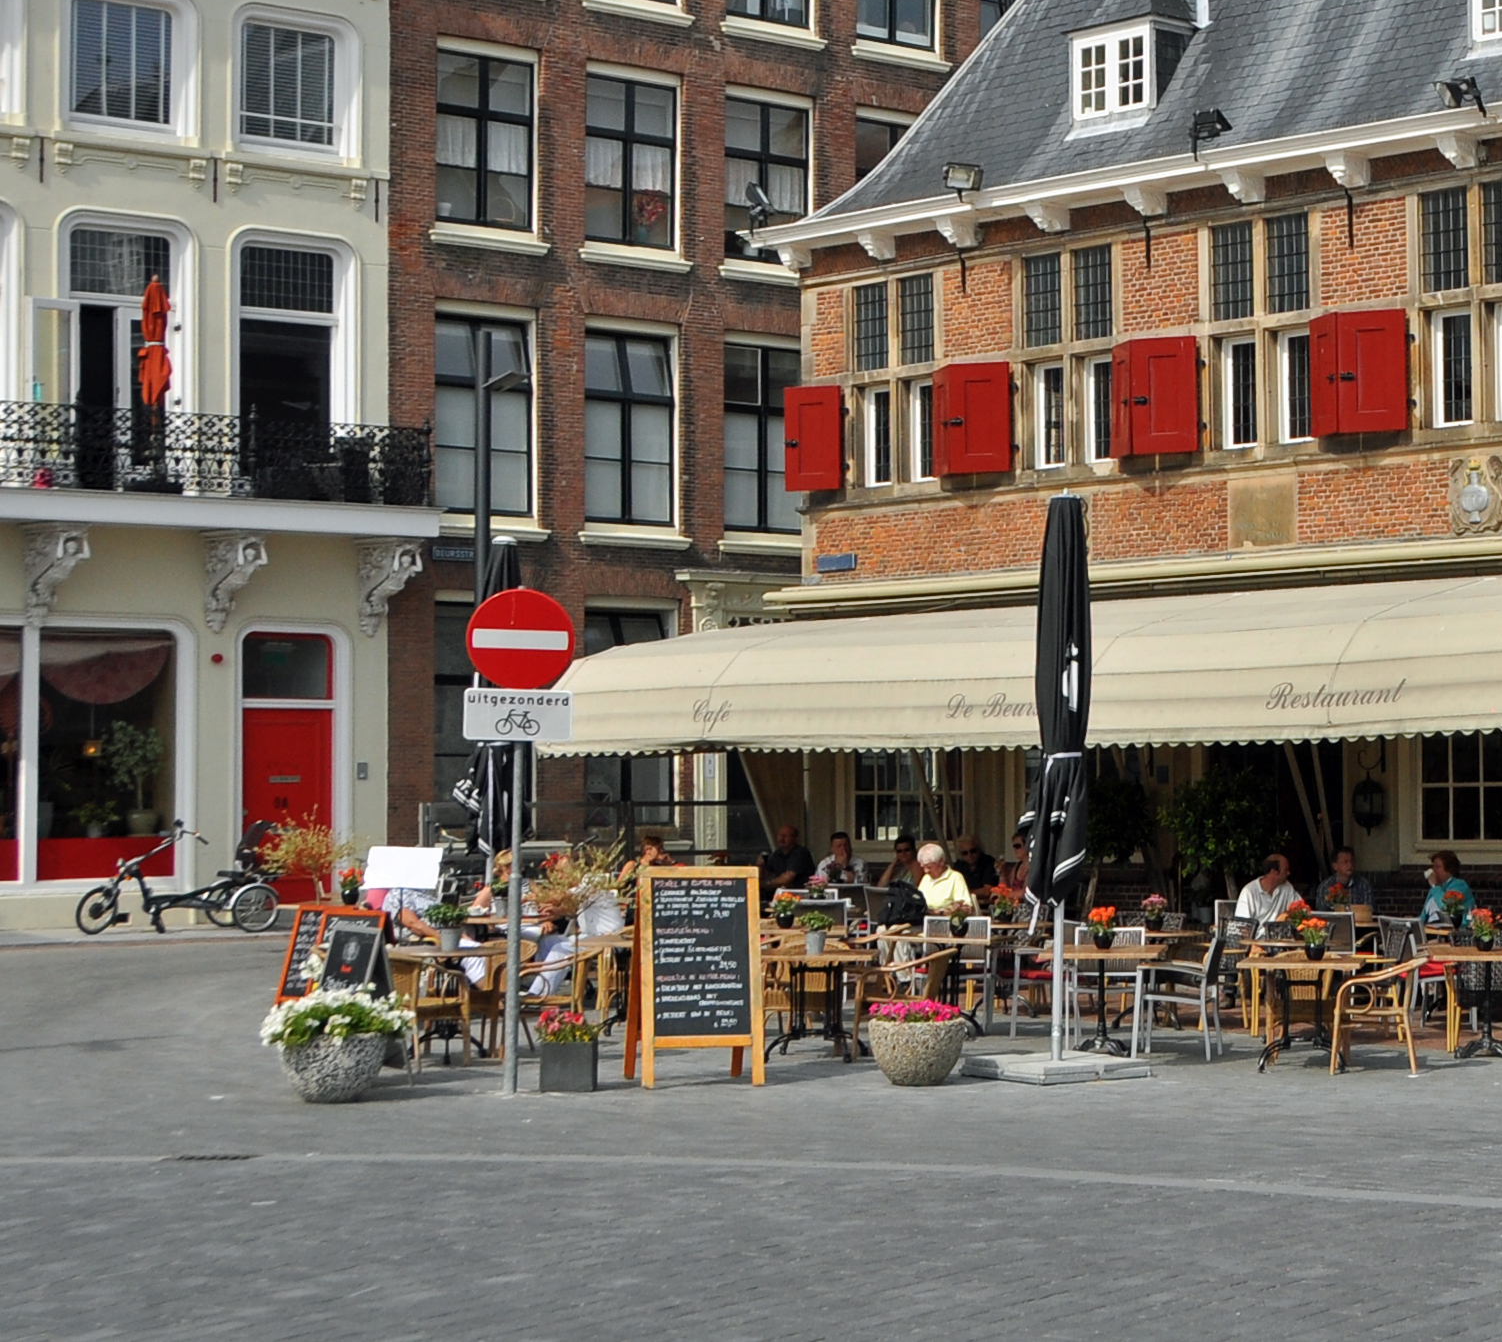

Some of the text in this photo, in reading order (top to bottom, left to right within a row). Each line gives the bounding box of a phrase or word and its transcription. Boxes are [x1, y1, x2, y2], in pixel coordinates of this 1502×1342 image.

[467, 692, 569, 707] uitgezonderd
[692, 699, 732, 733] Café
[945, 693, 974, 719] De
[1265, 678, 1407, 710] Restaurant
